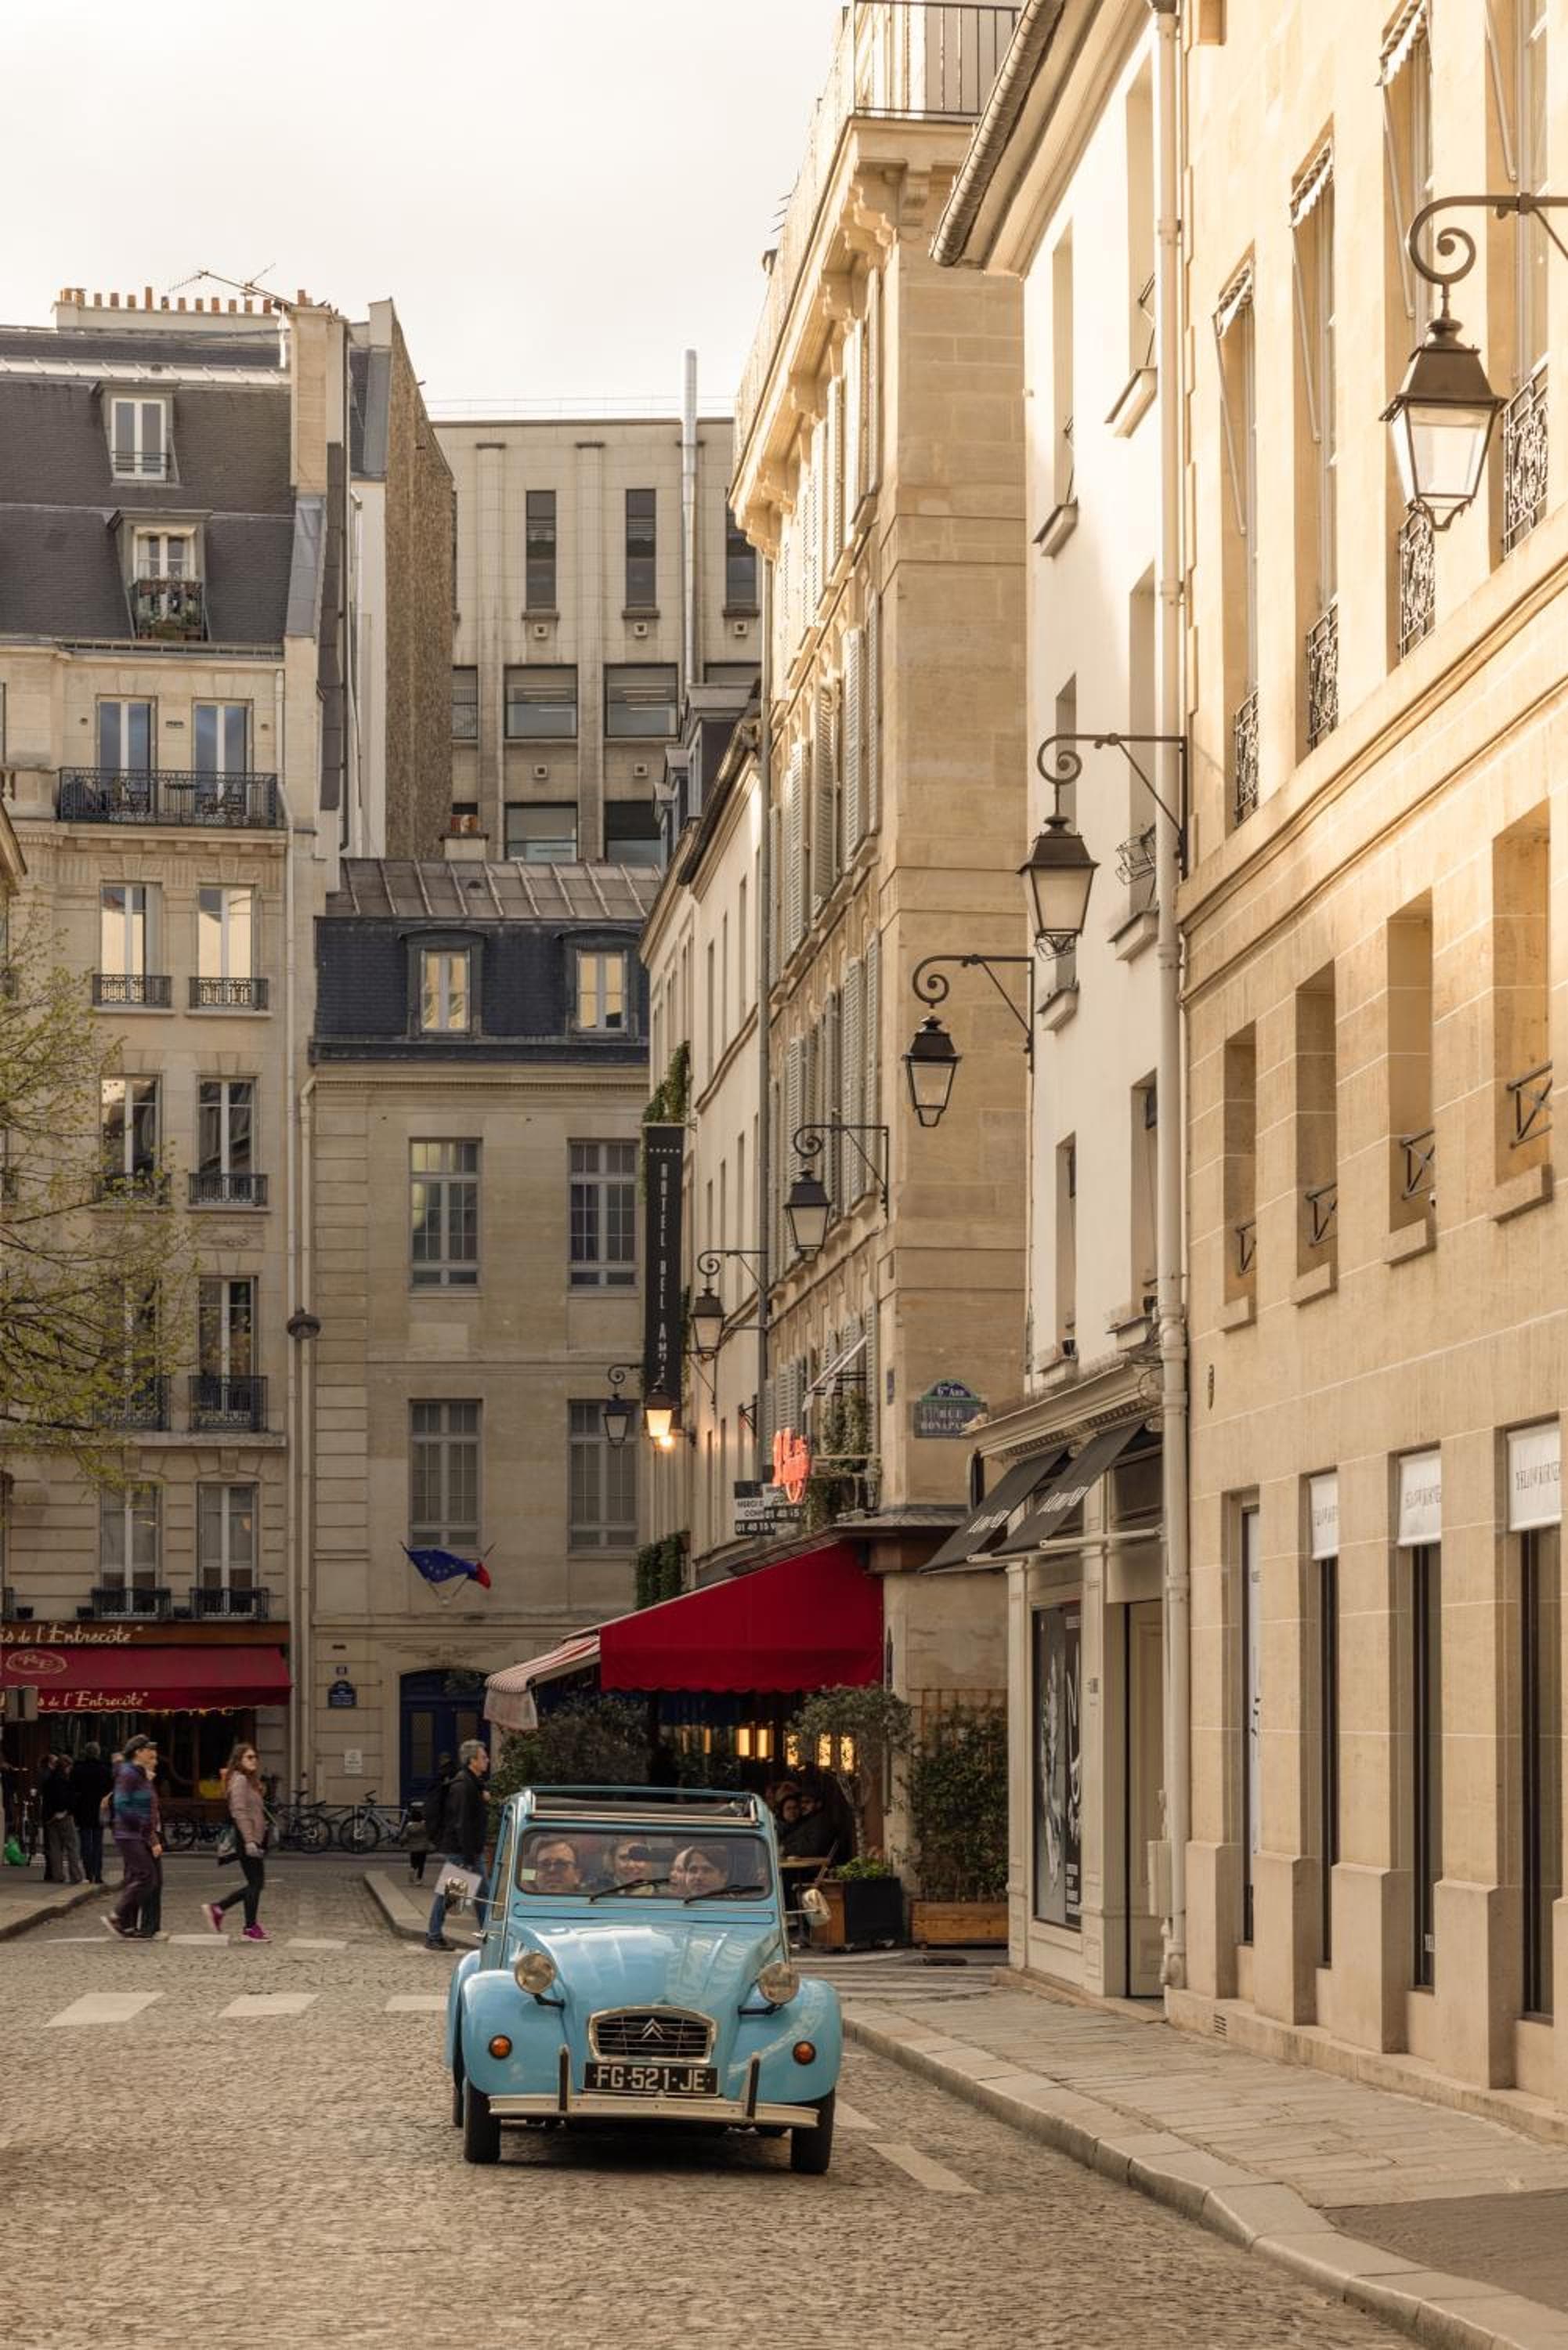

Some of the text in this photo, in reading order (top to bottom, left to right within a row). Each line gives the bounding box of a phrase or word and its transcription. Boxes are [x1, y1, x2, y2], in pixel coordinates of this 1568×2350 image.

[659, 1162, 668, 1247] HOTEL
[18, 1627, 31, 1643] de
[48, 1695, 60, 1706] de
